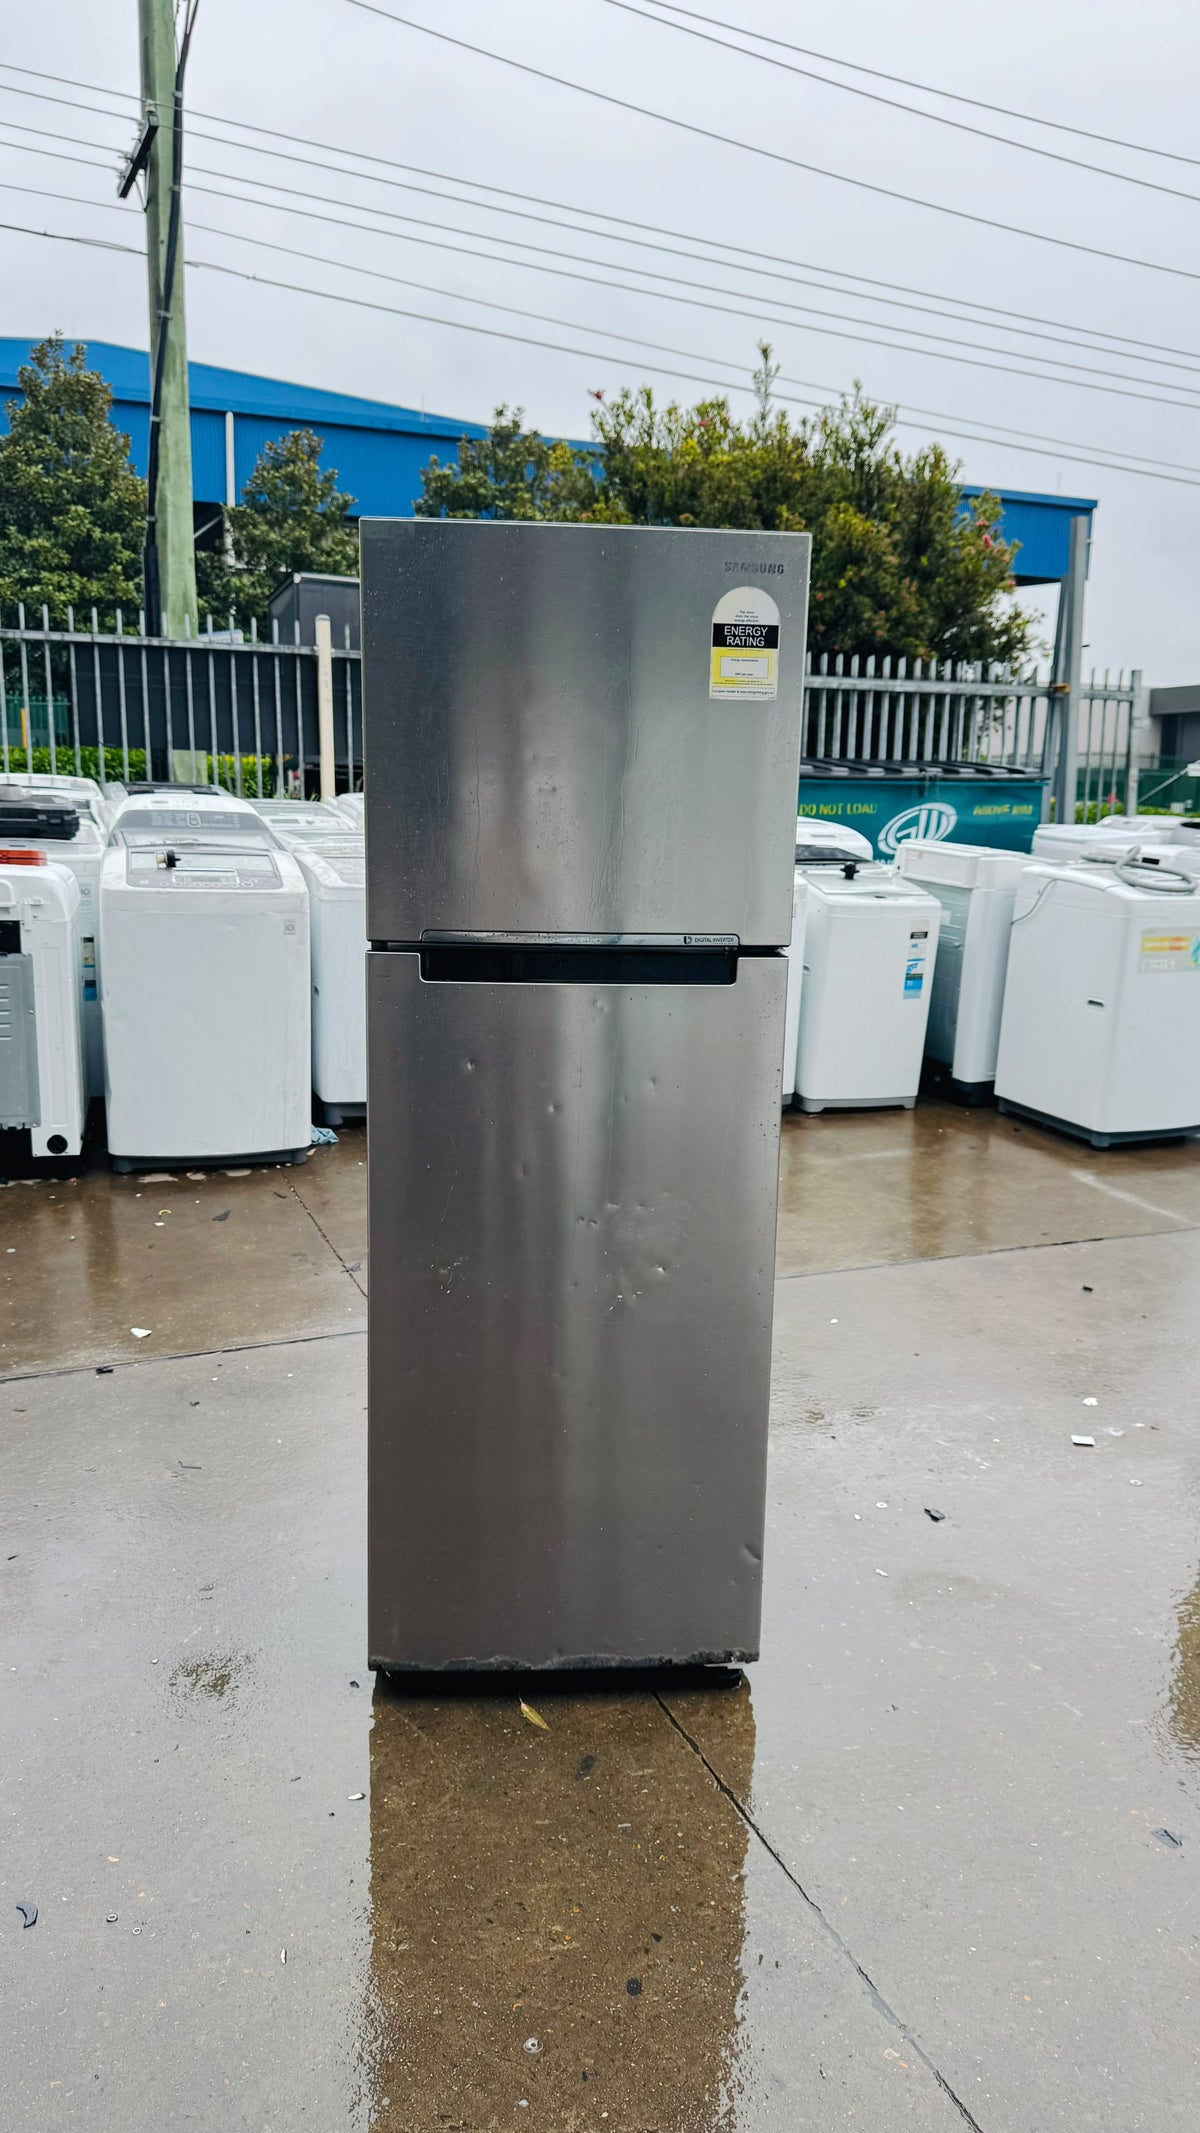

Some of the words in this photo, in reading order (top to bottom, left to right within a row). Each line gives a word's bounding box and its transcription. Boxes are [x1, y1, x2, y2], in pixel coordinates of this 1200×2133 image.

[725, 625, 768, 636] ENERGY
[726, 636, 764, 646] RATING
[799, 803, 816, 816] DO
[819, 803, 843, 815] NOT
[846, 802, 877, 815] LOAD
